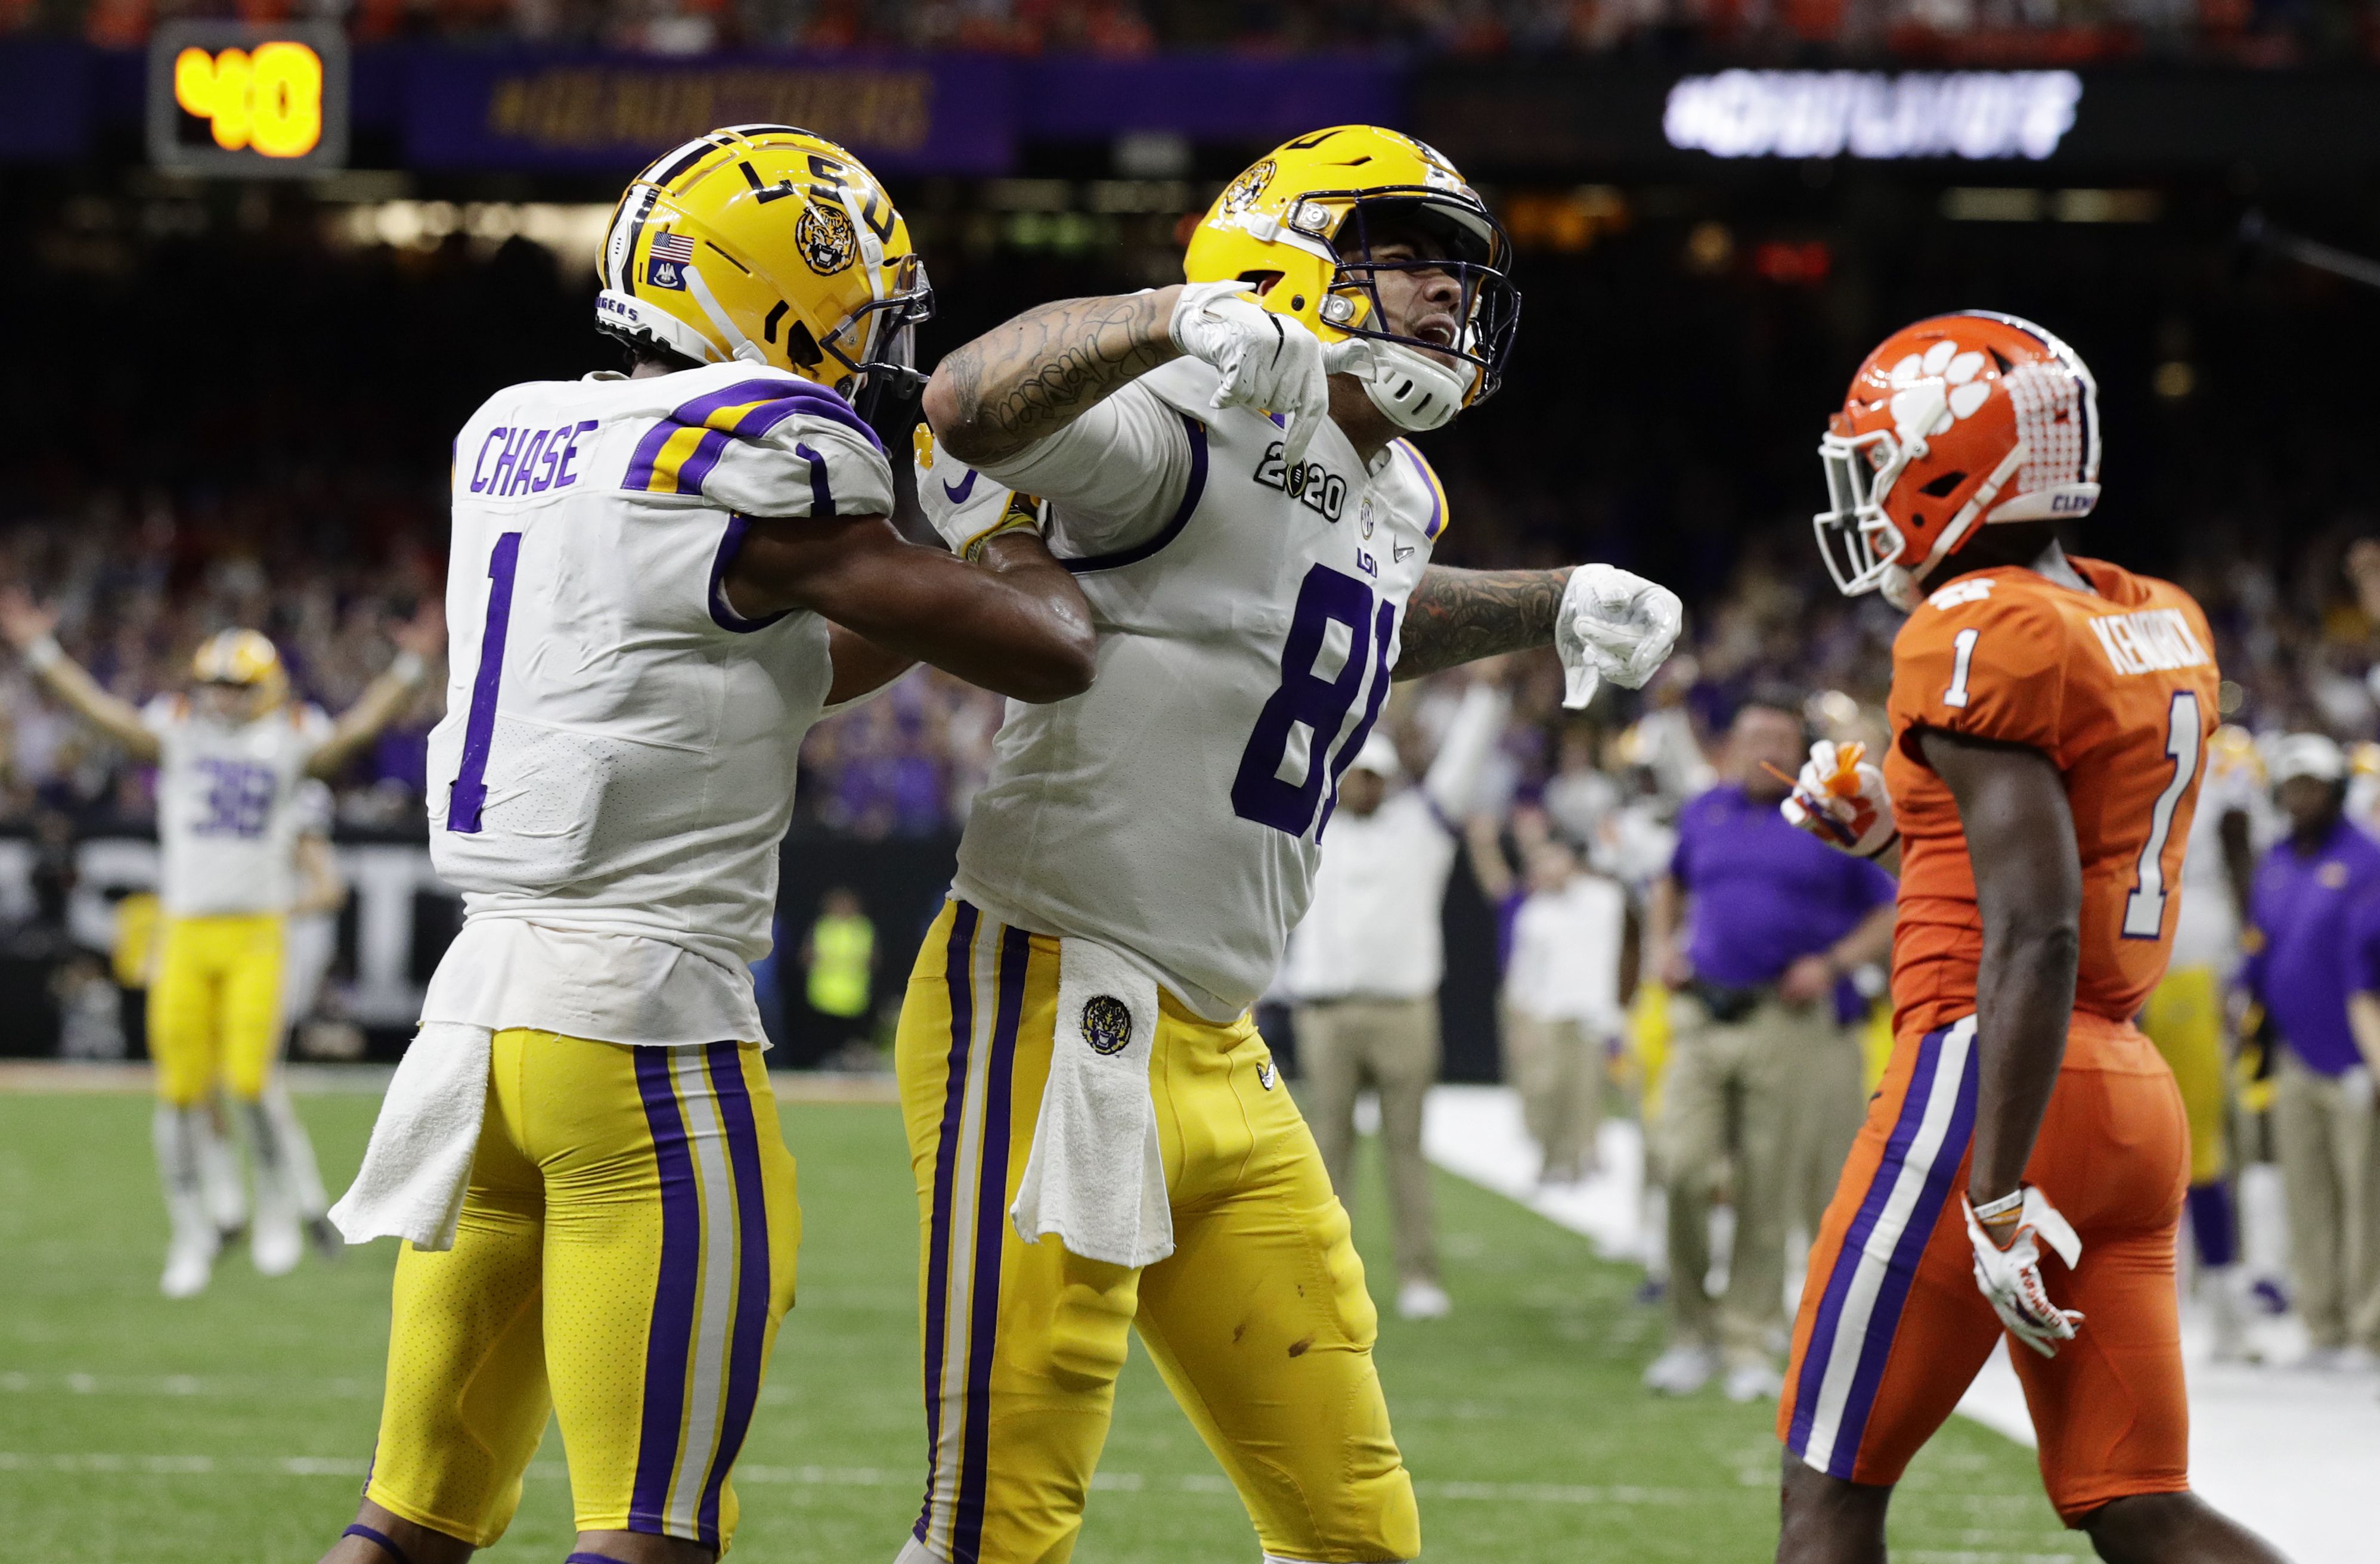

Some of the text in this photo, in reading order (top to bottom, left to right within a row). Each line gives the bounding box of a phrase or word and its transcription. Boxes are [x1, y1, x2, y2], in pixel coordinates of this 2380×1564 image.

[737, 154, 895, 245] LSU
[470, 420, 599, 496] CHASE
[795, 443, 836, 517] 1
[447, 532, 523, 832] 1
[1231, 562, 1396, 845] 81
[1944, 628, 1979, 708] 1
[2121, 690, 2201, 940] 1
